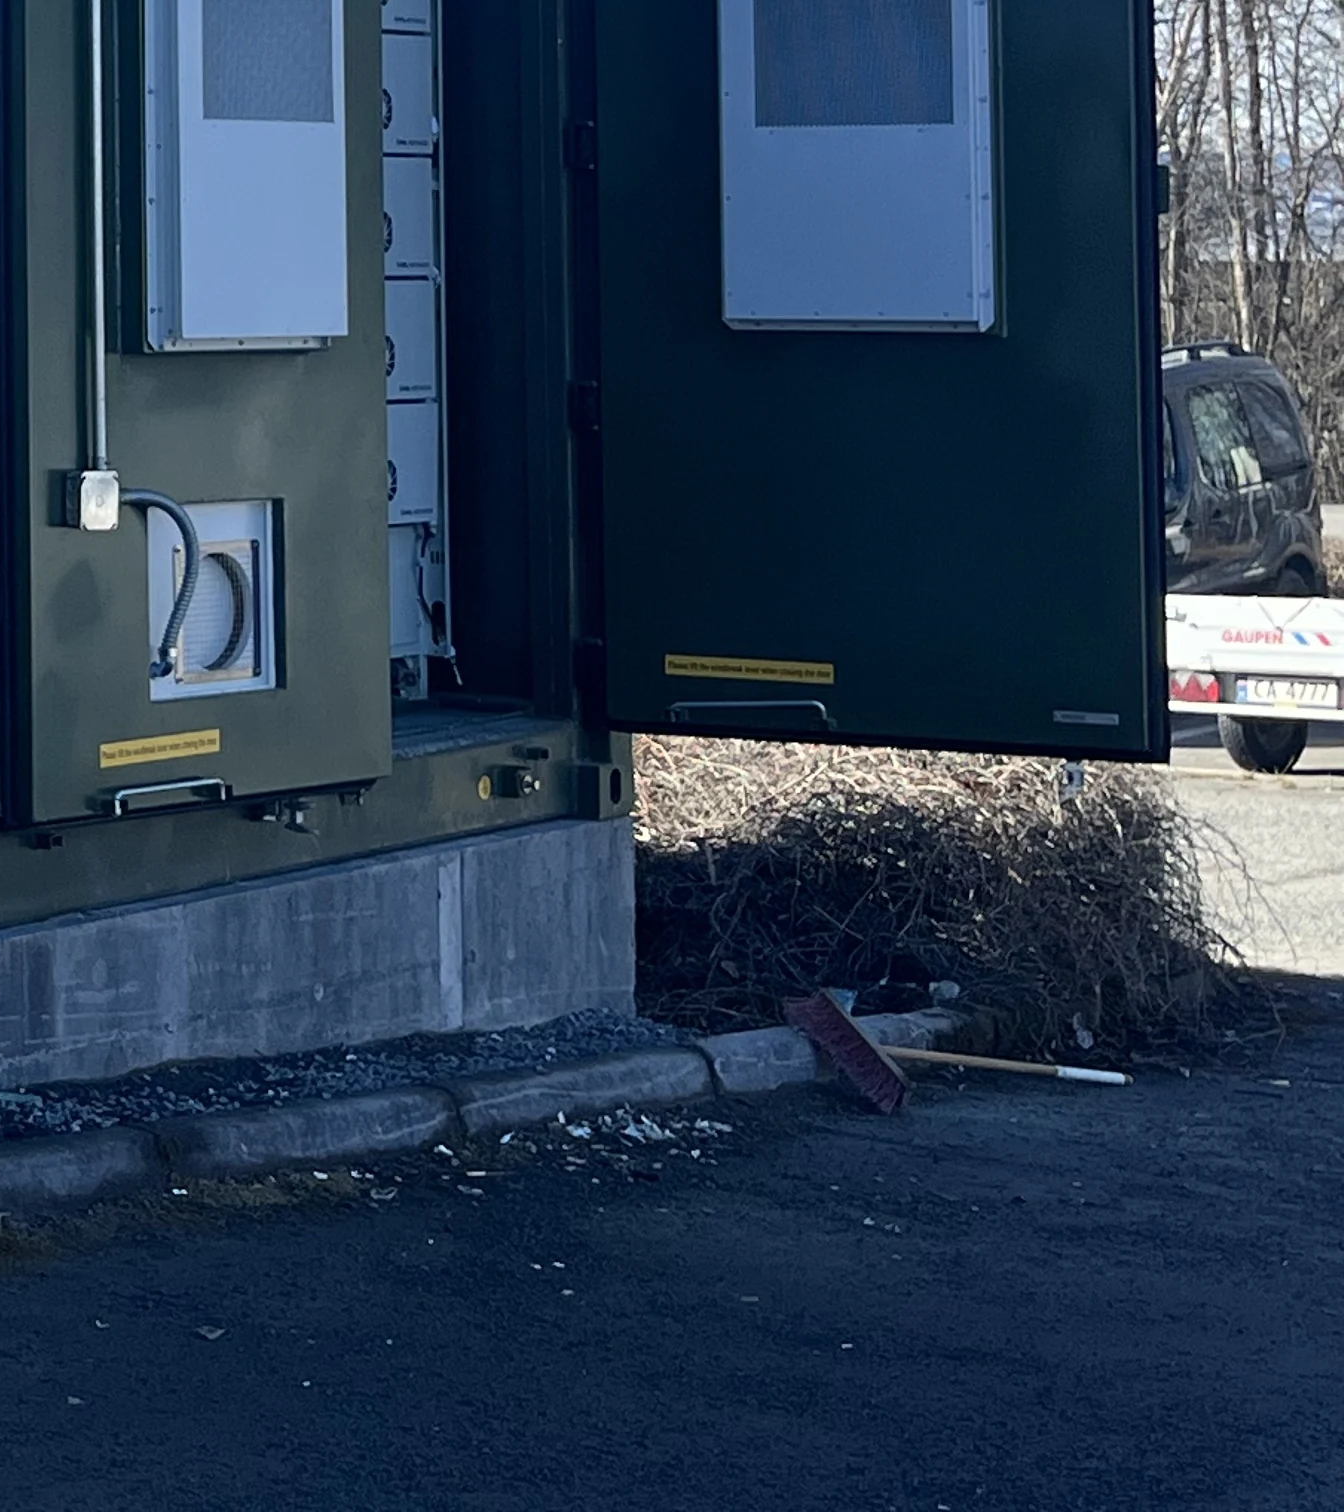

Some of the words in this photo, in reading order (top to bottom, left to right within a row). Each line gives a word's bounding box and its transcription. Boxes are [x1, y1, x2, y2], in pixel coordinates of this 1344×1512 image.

[1221, 628, 1284, 645] GAUPEN
[1254, 679, 1277, 700] CA
[1286, 679, 1330, 702] 4777
